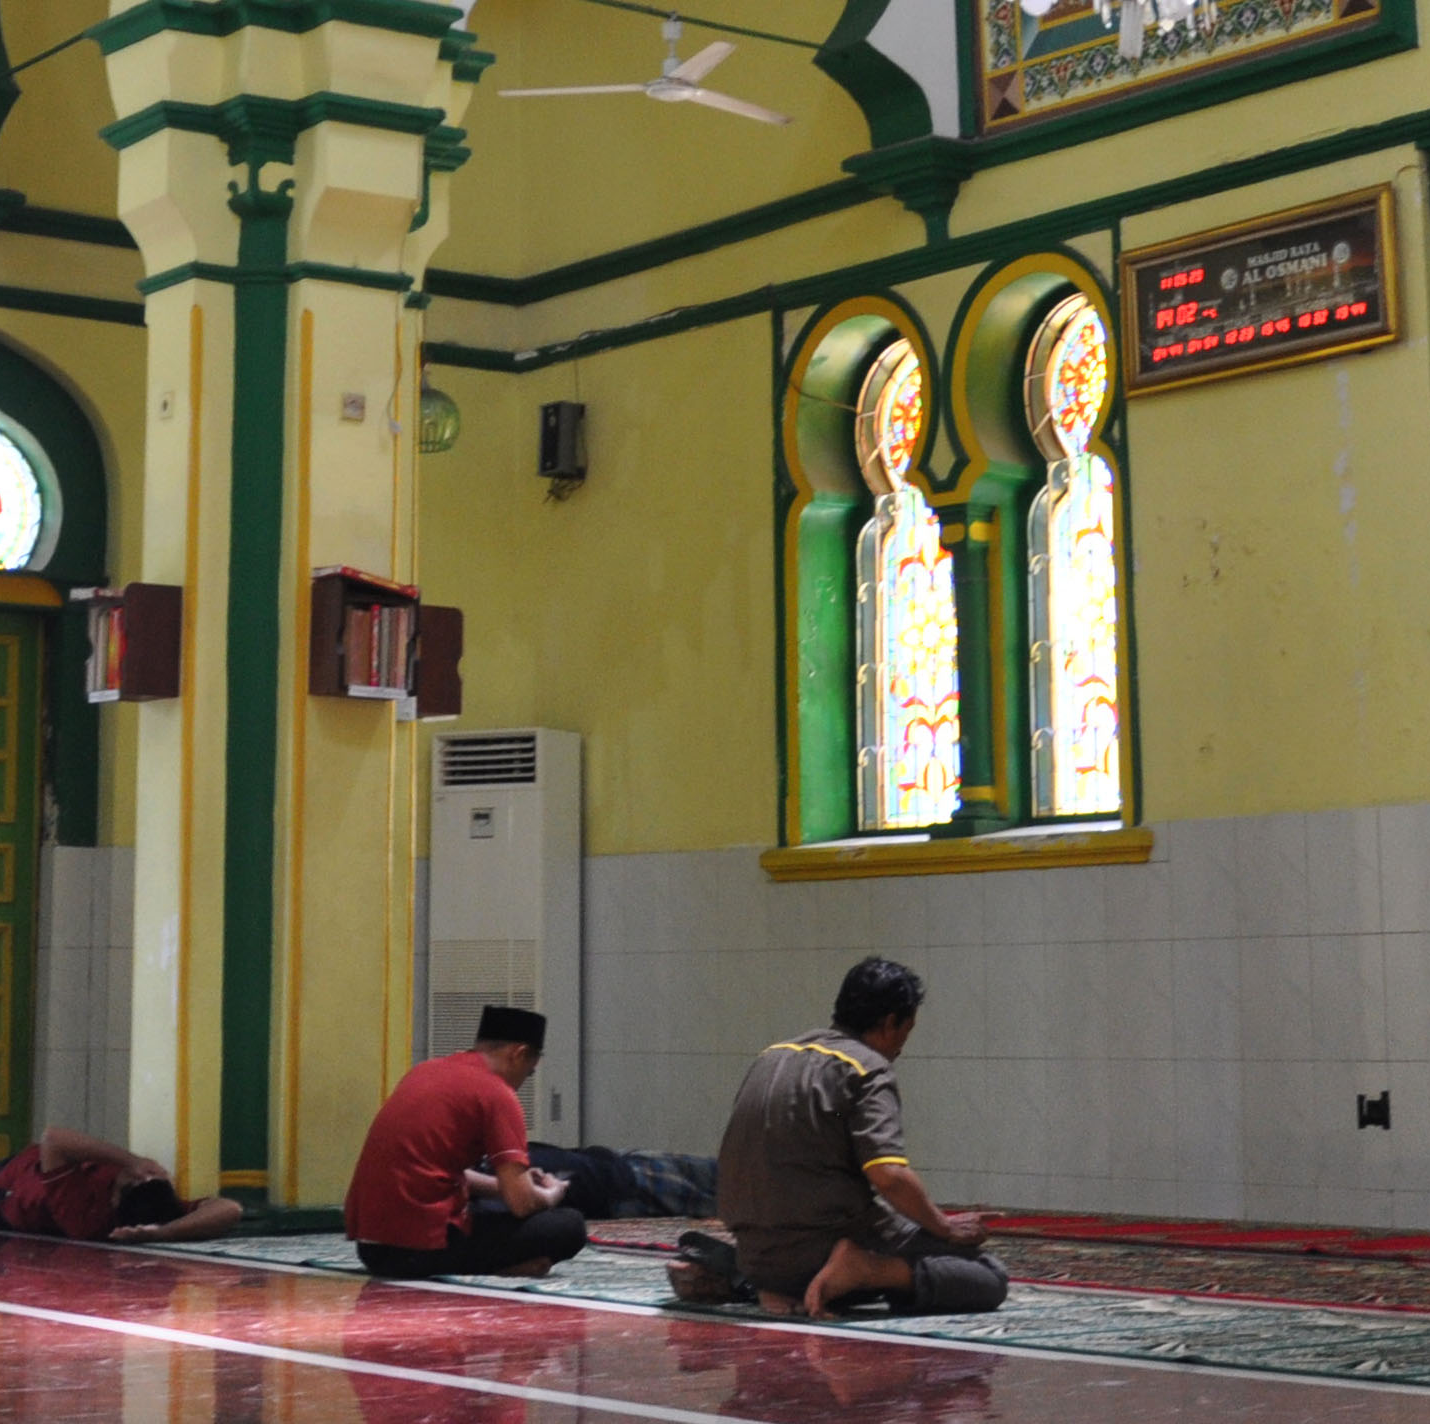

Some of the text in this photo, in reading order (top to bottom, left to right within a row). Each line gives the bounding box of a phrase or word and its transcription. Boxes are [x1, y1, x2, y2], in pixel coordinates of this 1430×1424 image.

[1242, 252, 1328, 285] AL OSMANI
[1247, 249, 1288, 267] MASJID
